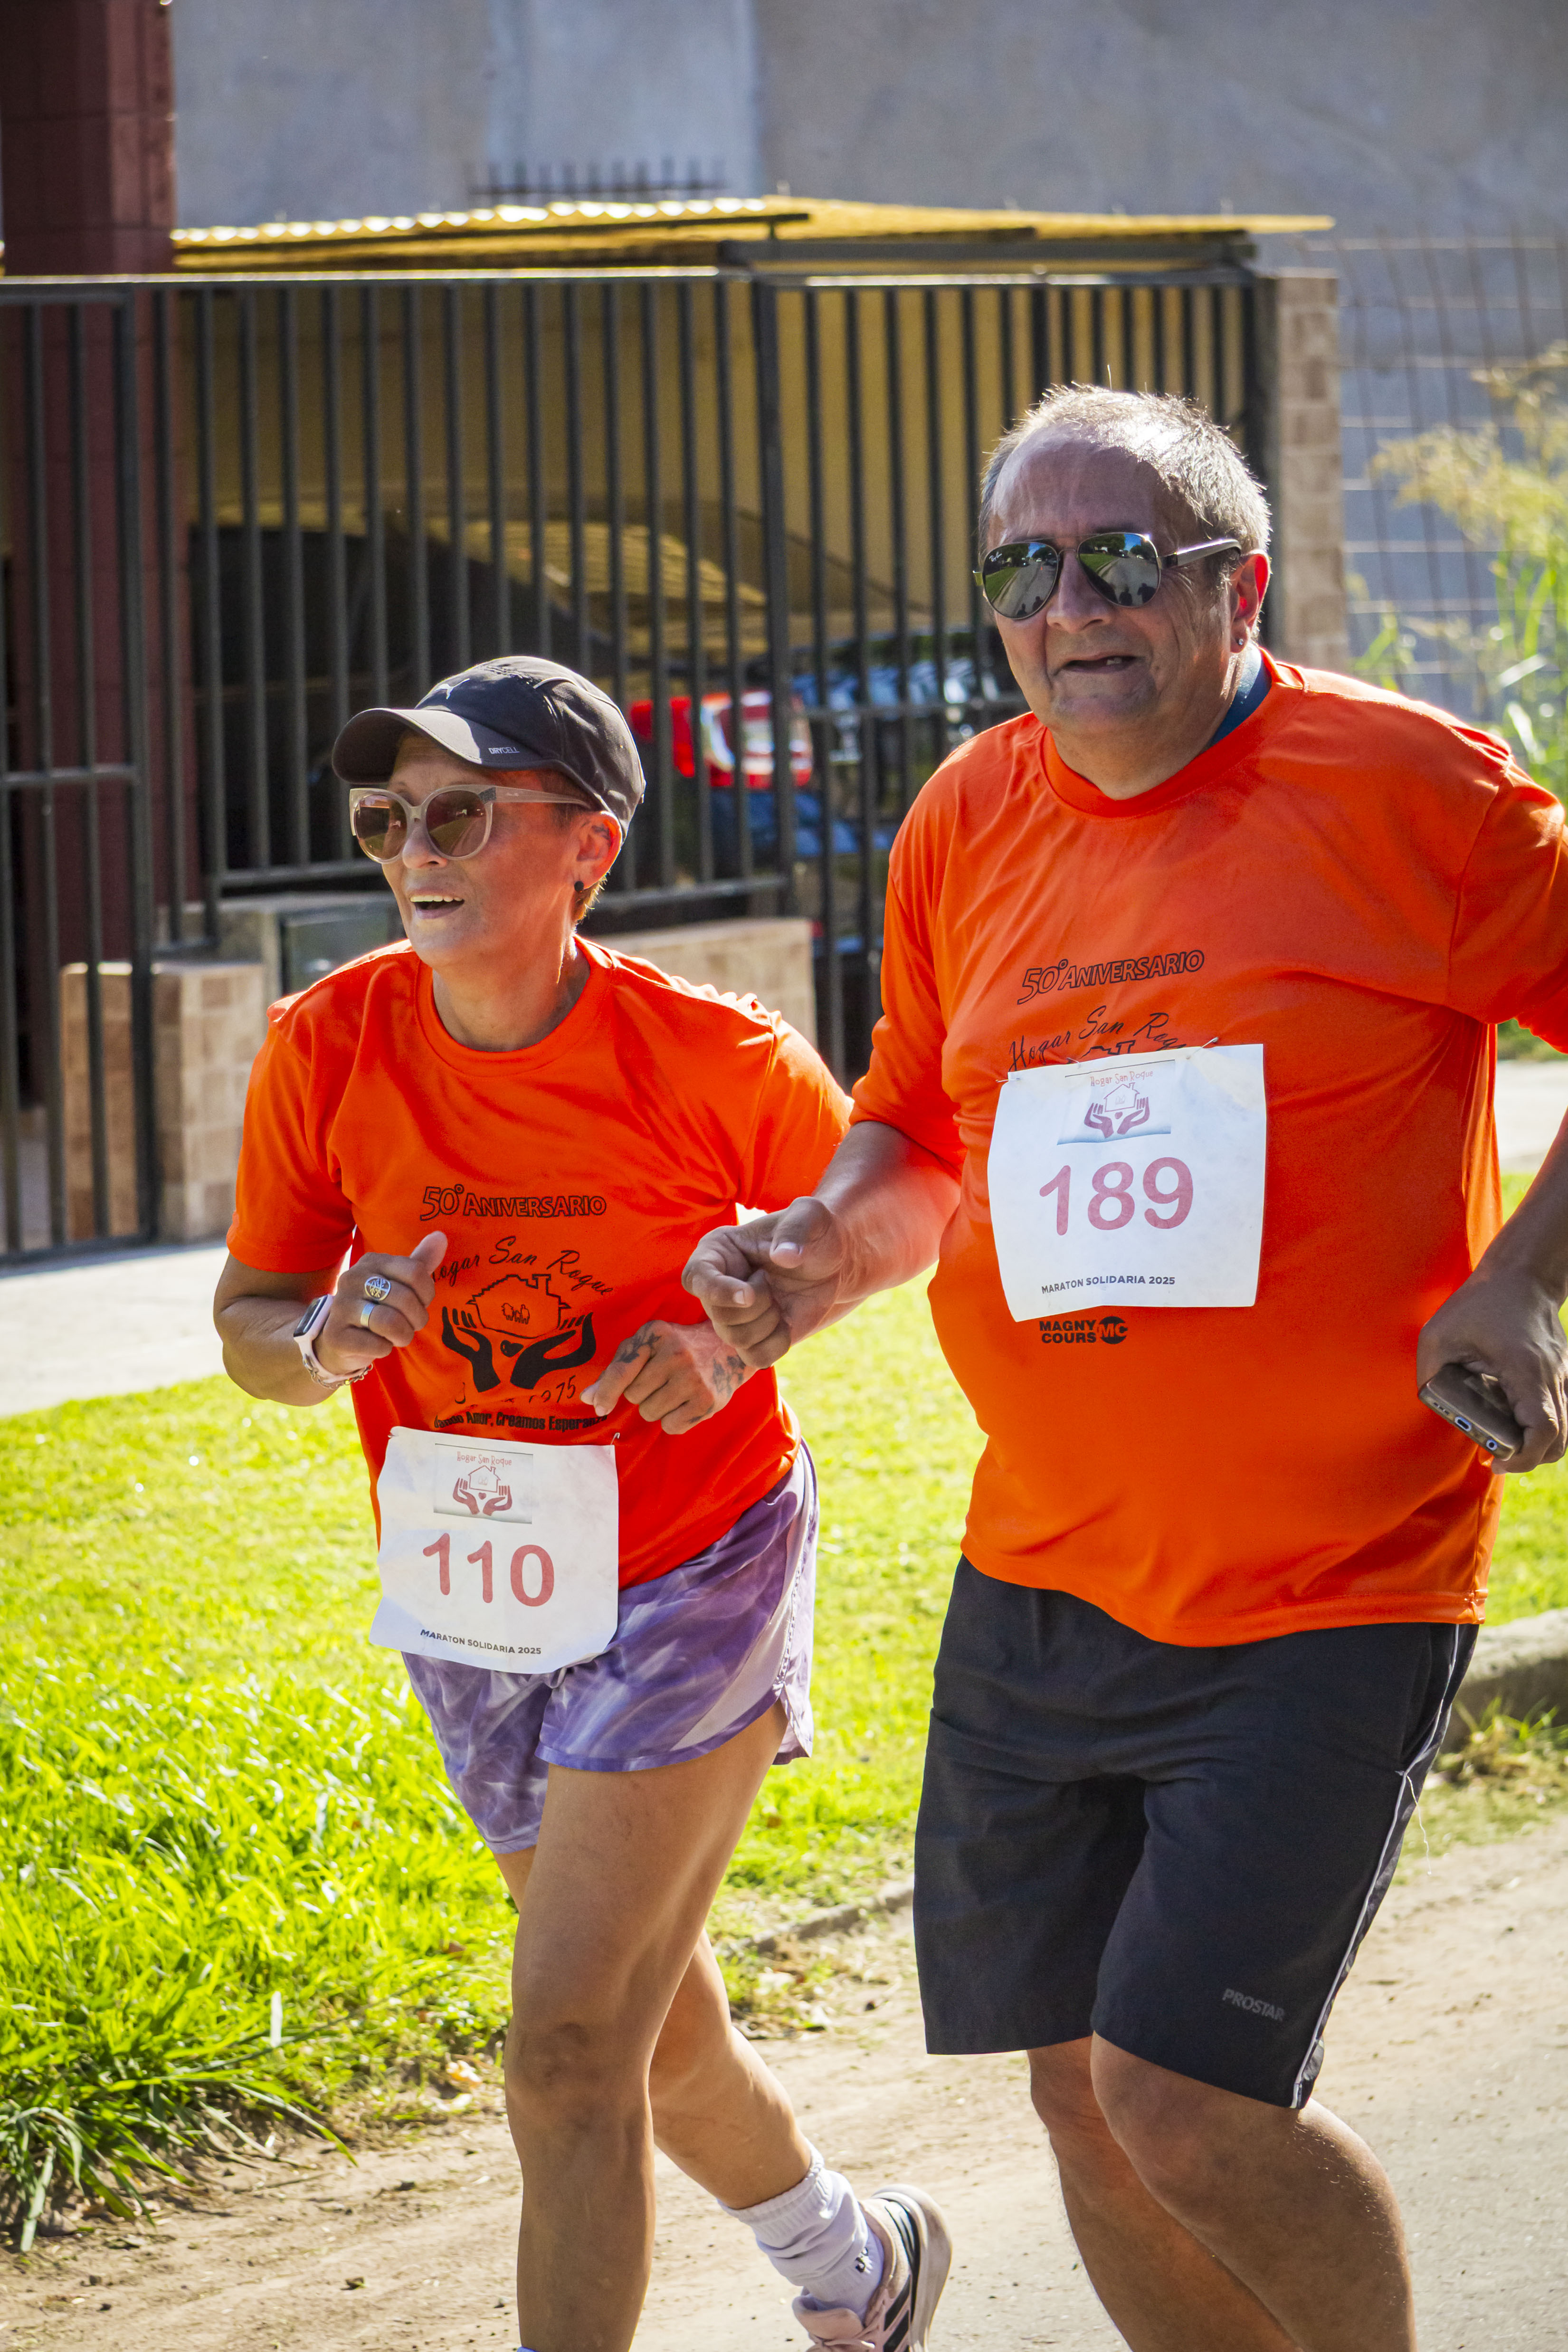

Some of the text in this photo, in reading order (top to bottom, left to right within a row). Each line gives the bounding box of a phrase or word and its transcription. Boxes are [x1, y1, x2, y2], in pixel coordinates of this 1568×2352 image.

[1008, 1005, 1187, 1072] Hogar San Roq
[1090, 1071, 1153, 1087] Hogar San Roque
[1039, 1157, 1194, 1236] 189
[431, 1236, 613, 1295] ogar San Roque
[1042, 1276, 1175, 1294] MARATON SOLIDARIA 2025
[1039, 1320, 1128, 1340] MAGNY MC
[1041, 1332, 1097, 1343] COURS
[496, 1412, 545, 1430] Creamos
[457, 1451, 512, 1467] Hogar San Roque
[423, 1533, 554, 1607] 110
[420, 1629, 465, 1645] MARATON
[467, 1639, 515, 1653] SOLIDARIA
[1222, 1988, 1284, 2021] PROSTAR
